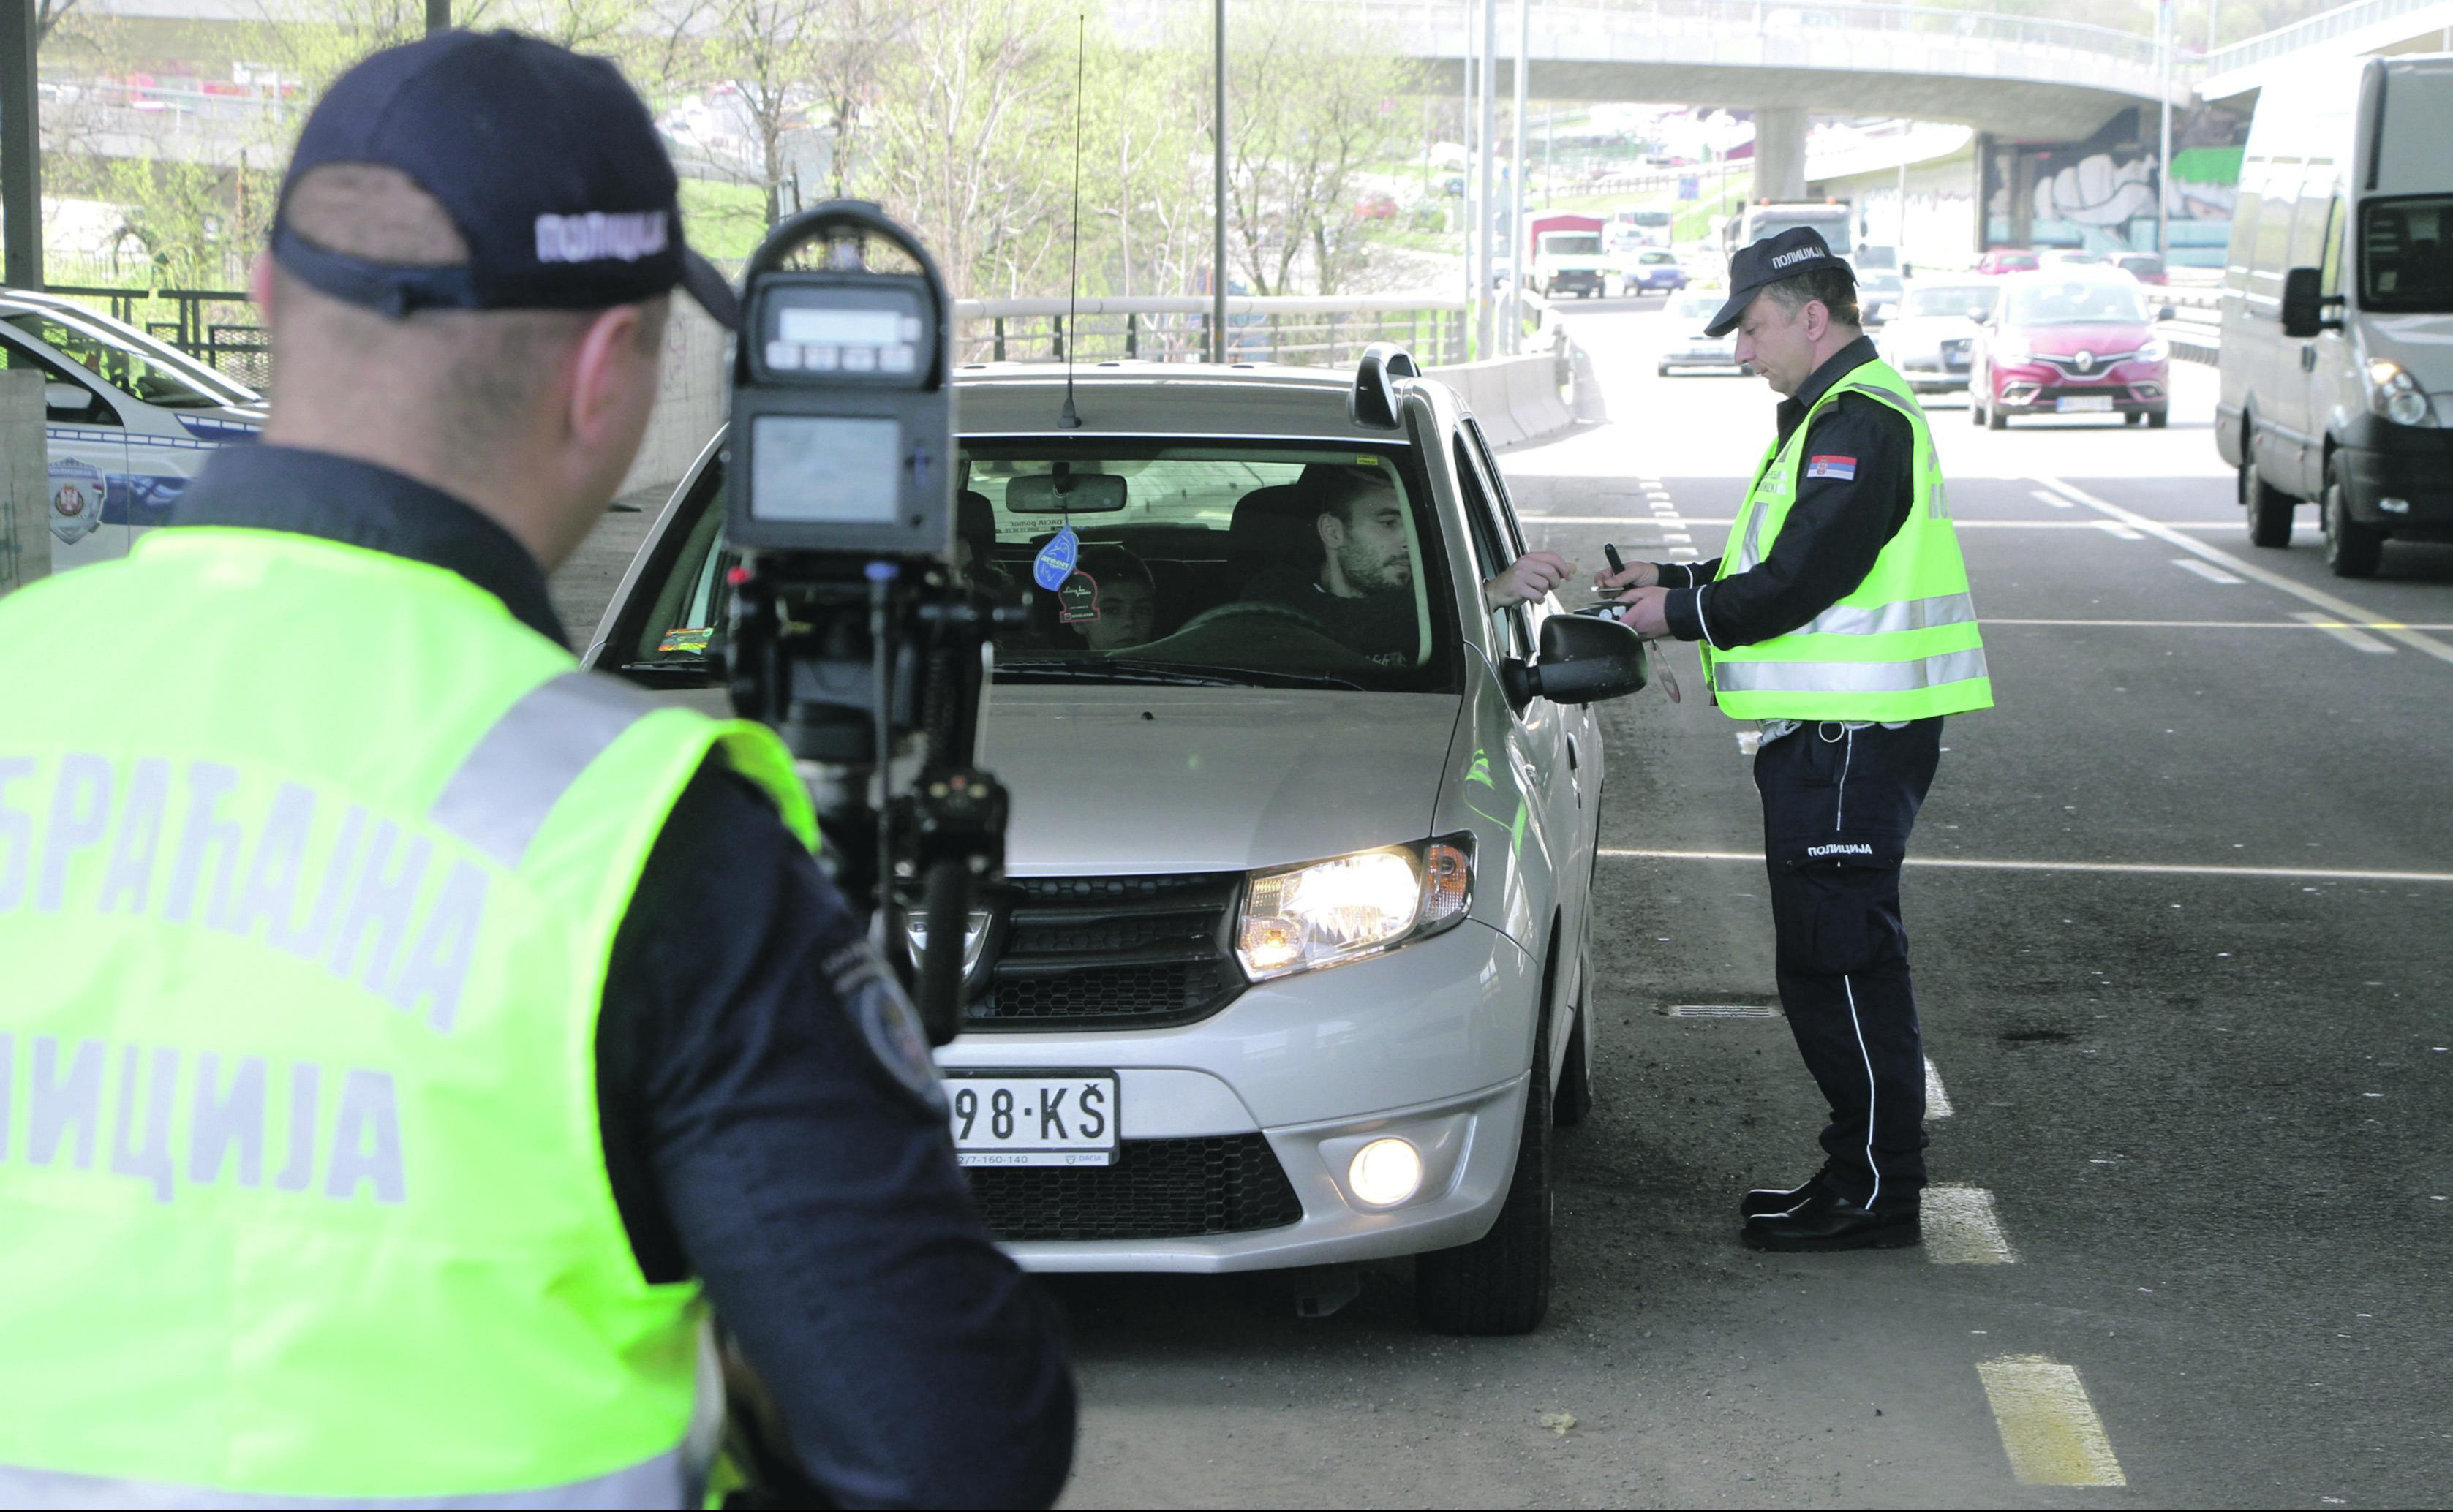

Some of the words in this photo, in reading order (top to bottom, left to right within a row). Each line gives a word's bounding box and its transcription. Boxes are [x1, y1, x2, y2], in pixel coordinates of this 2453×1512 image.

[1771, 246, 1825, 270] ПОЛИЦИЈА
[1807, 844, 1873, 857] ПОЛИЦИЈА
[0, 1033, 407, 1204] ИЦИЈА
